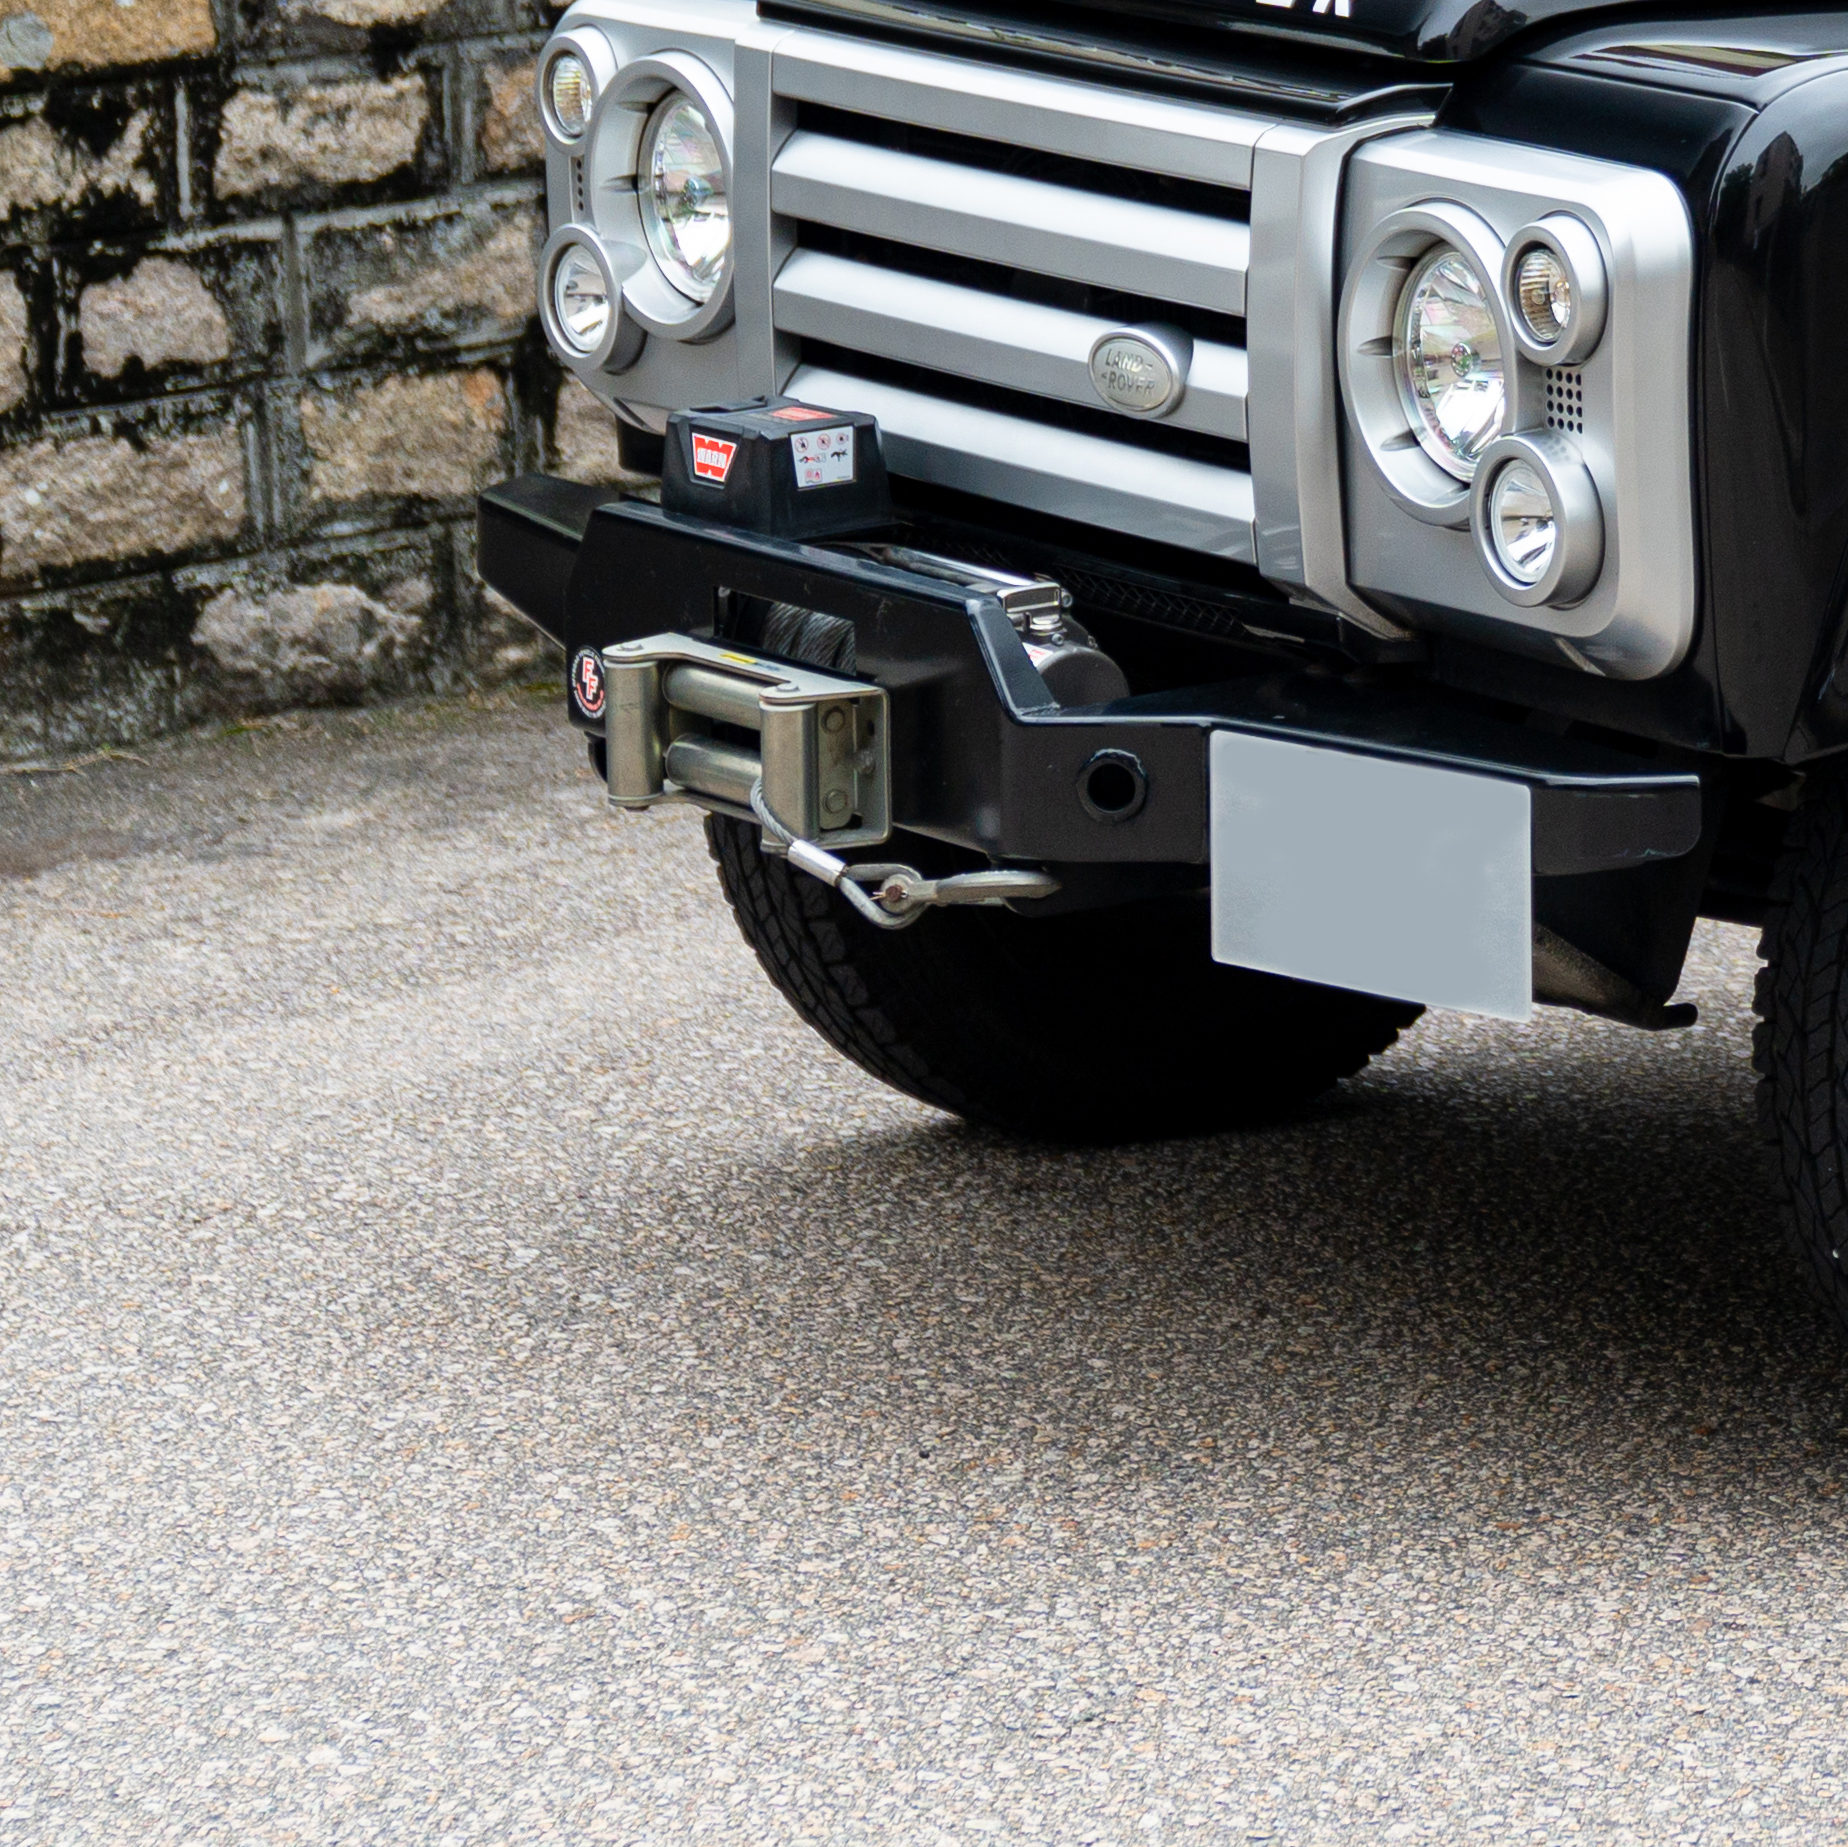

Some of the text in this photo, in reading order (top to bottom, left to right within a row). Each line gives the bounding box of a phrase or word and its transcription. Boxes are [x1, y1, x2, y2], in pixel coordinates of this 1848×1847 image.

[1105, 348, 1144, 373] LAND
[1108, 370, 1155, 394] ROVER
[696, 447, 727, 469] WARN
